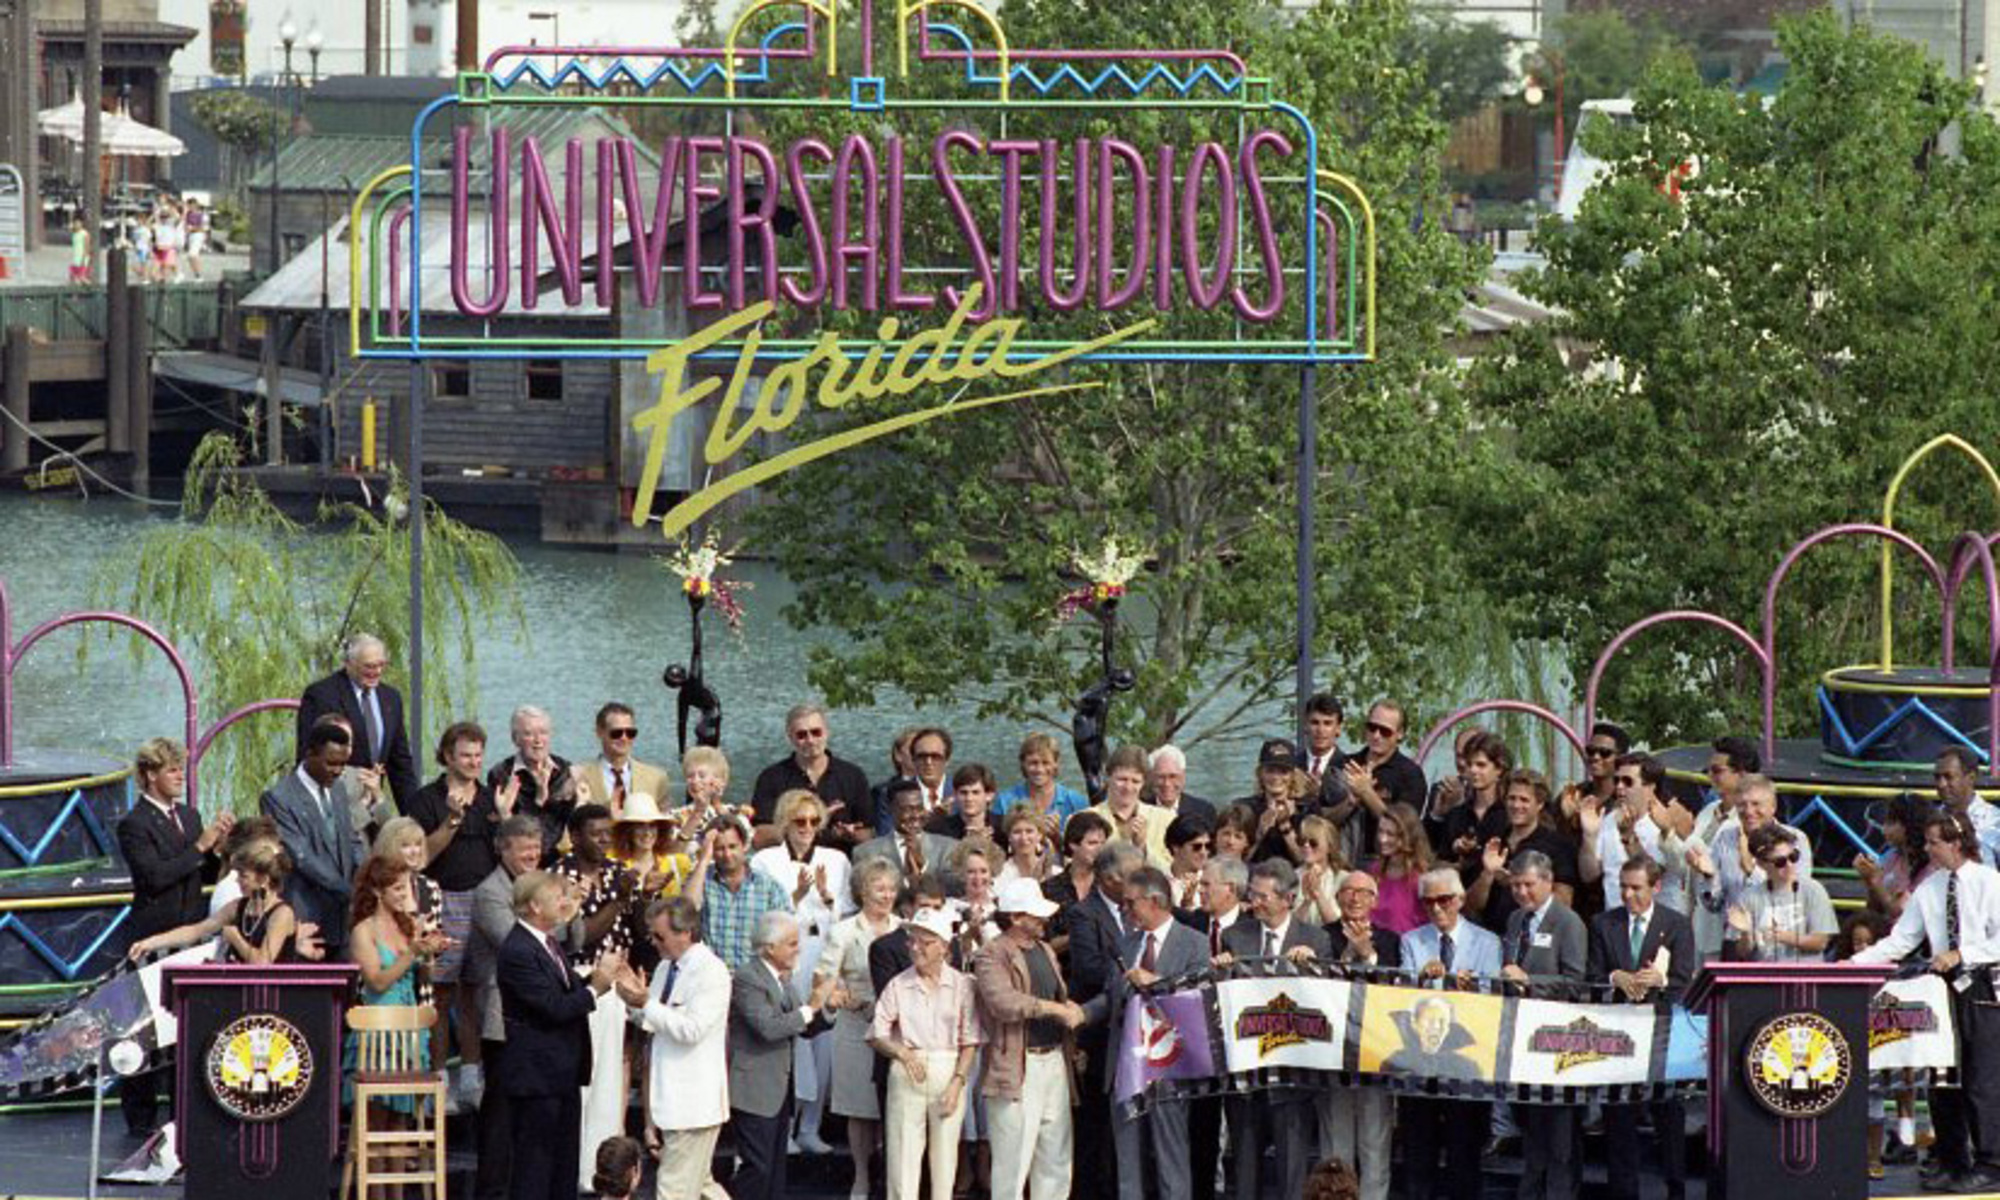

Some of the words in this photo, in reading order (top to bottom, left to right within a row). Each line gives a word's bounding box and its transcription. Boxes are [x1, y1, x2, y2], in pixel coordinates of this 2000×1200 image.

[451, 124, 935, 316] UNIVERSAL
[933, 130, 1292, 321] STUDIOS
[632, 281, 1157, 530] Florida
